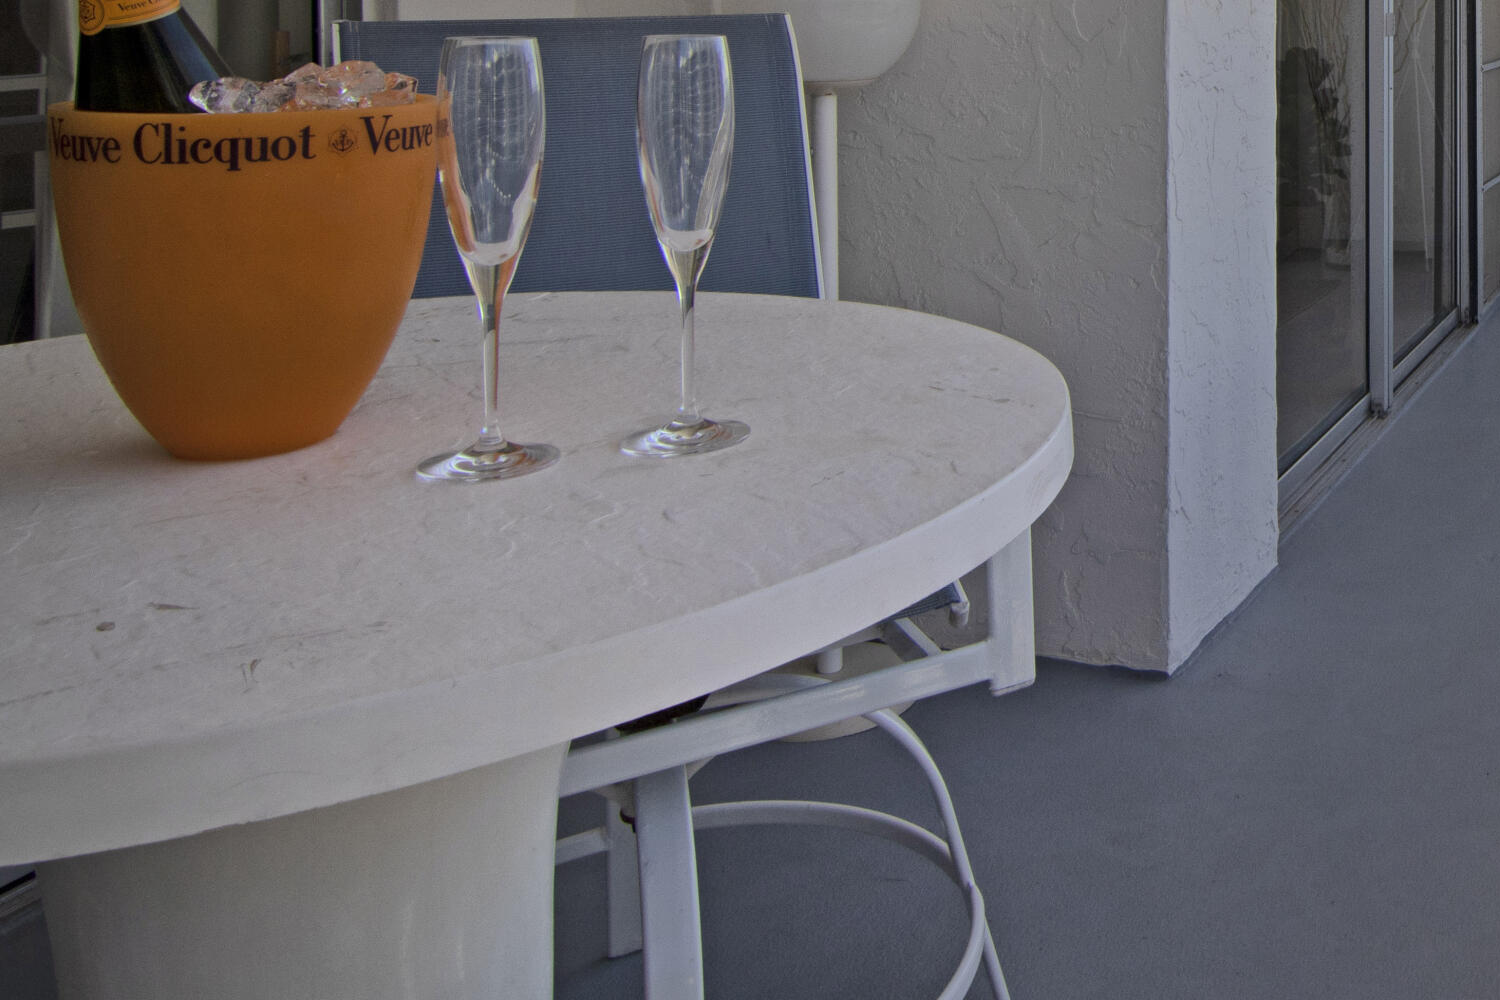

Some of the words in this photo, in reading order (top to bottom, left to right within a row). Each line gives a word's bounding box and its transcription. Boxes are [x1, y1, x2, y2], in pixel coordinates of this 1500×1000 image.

[117, 0, 147, 12] Veuve
[50, 116, 121, 164] Veuve
[134, 123, 316, 171] Clicquot
[360, 115, 433, 154] Veuve
